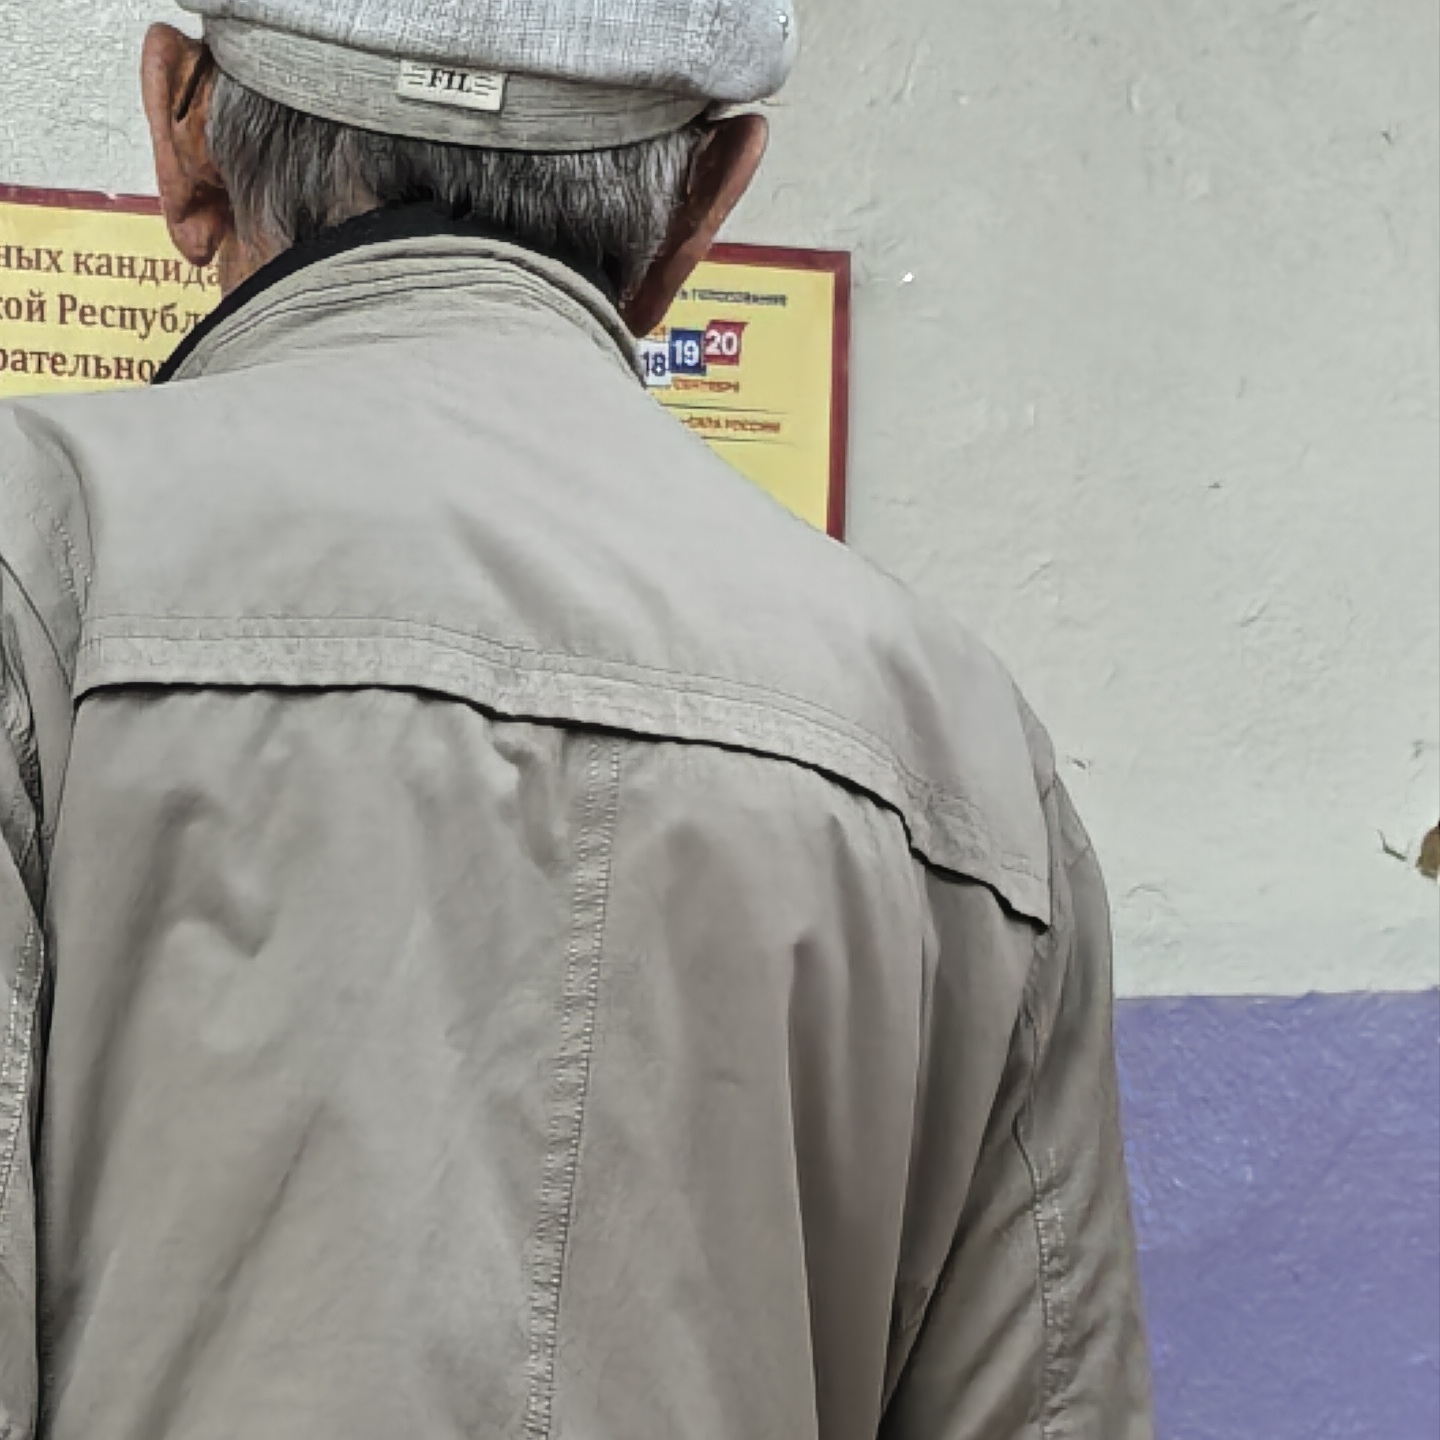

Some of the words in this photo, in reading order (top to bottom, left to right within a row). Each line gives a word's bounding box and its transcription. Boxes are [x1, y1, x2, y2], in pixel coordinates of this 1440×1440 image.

[73, 251, 220, 291] кандида
[57, 291, 202, 340] Республ
[642, 350, 667, 377] 18
[673, 339, 700, 367] 19
[705, 329, 738, 357] 20
